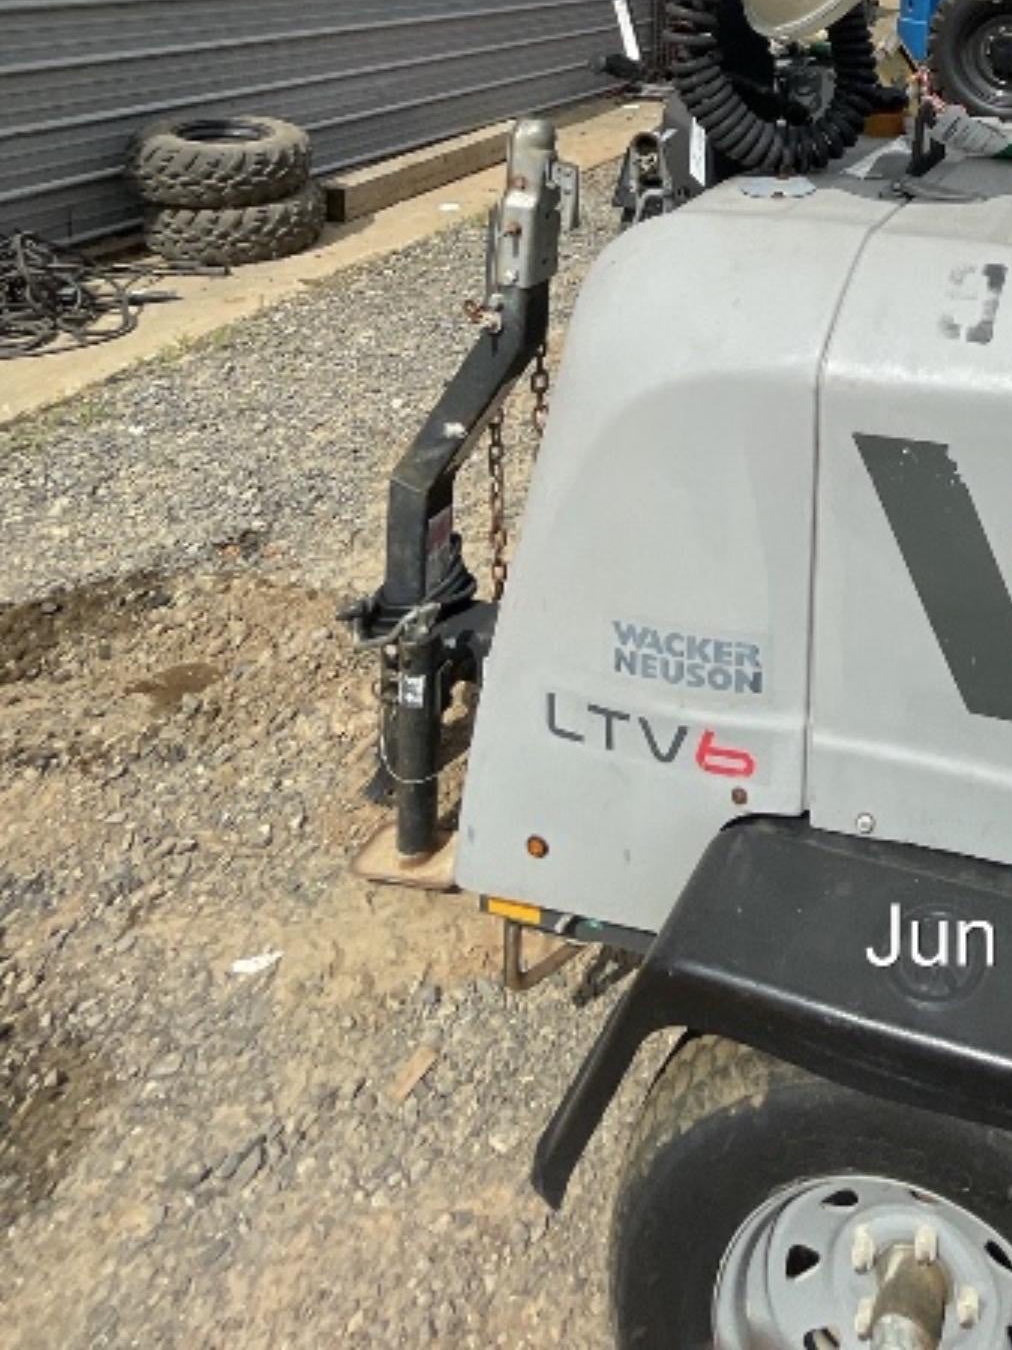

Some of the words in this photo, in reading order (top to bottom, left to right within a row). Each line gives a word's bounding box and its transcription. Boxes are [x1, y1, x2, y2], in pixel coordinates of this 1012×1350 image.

[612, 620, 763, 669] WACKER
[613, 647, 763, 694] NEUSON
[546, 692, 757, 778] LTV6
